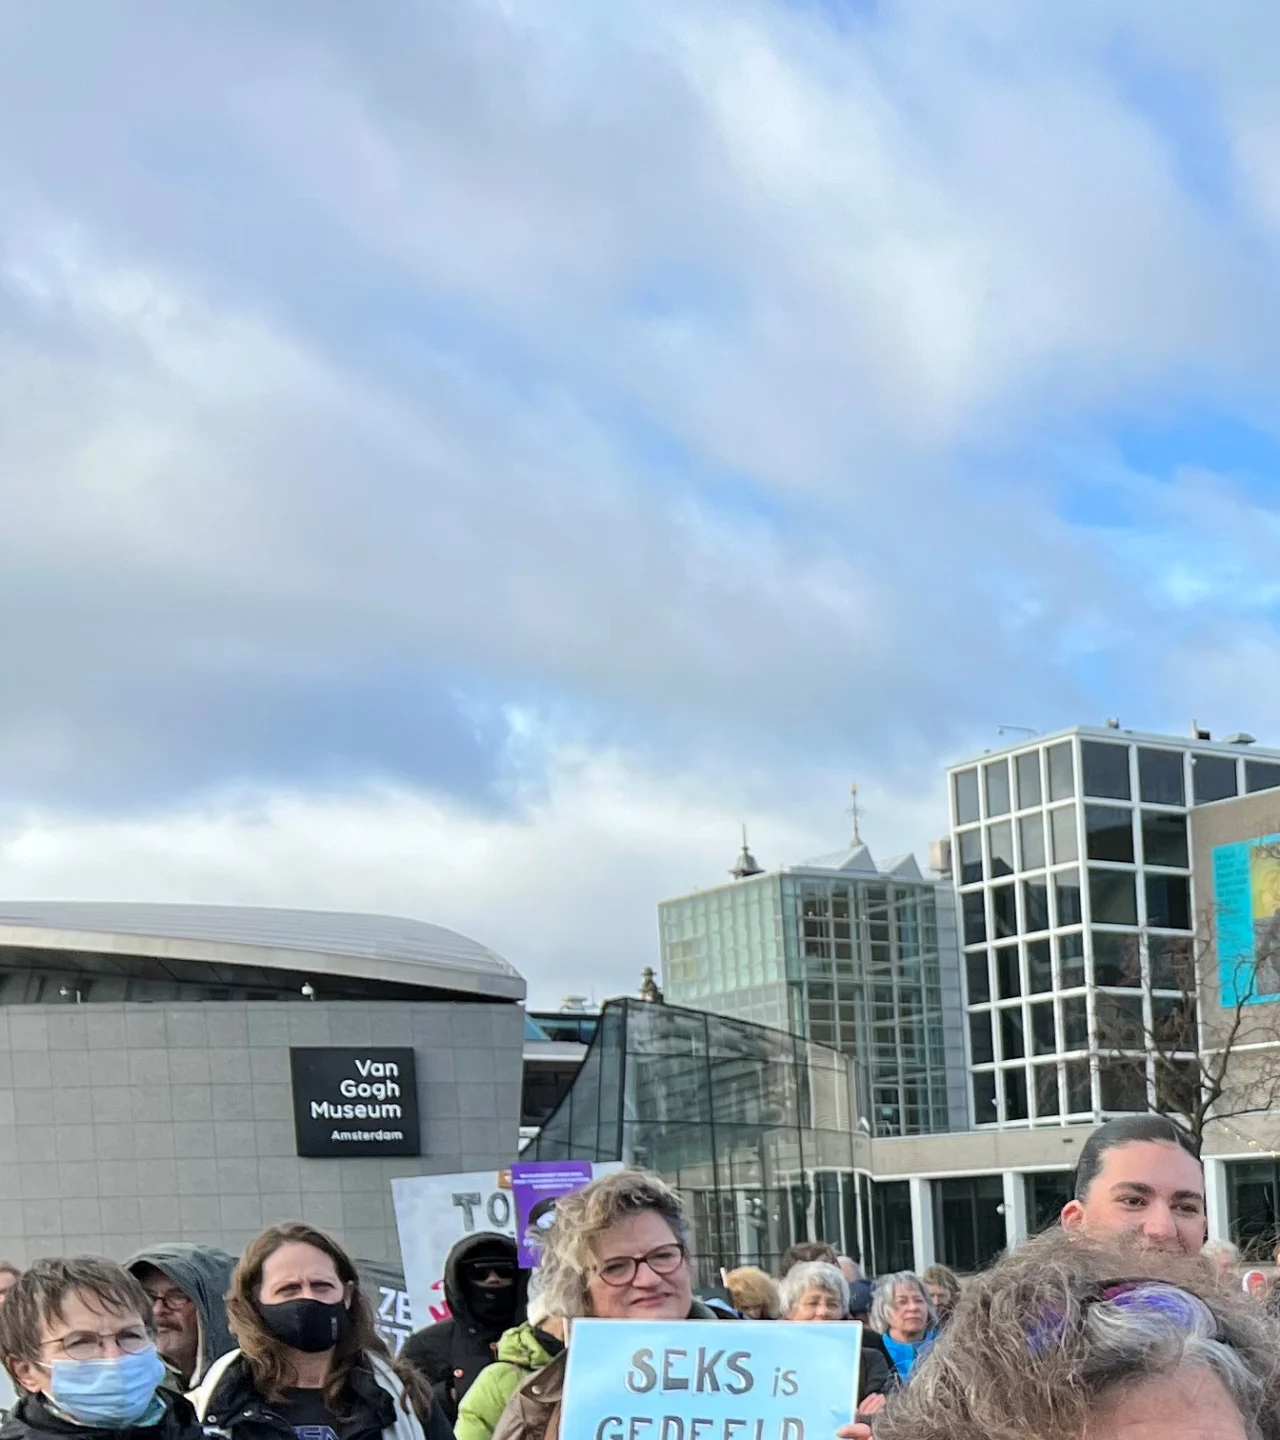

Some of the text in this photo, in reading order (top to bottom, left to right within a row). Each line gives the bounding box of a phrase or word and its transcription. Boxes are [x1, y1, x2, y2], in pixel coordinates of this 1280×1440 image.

[354, 1059, 399, 1077] Van
[340, 1079, 400, 1101] Gogh
[310, 1101, 402, 1119] Museum
[331, 1130, 404, 1140] Amsterdam
[625, 1347, 754, 1395] SEKS
